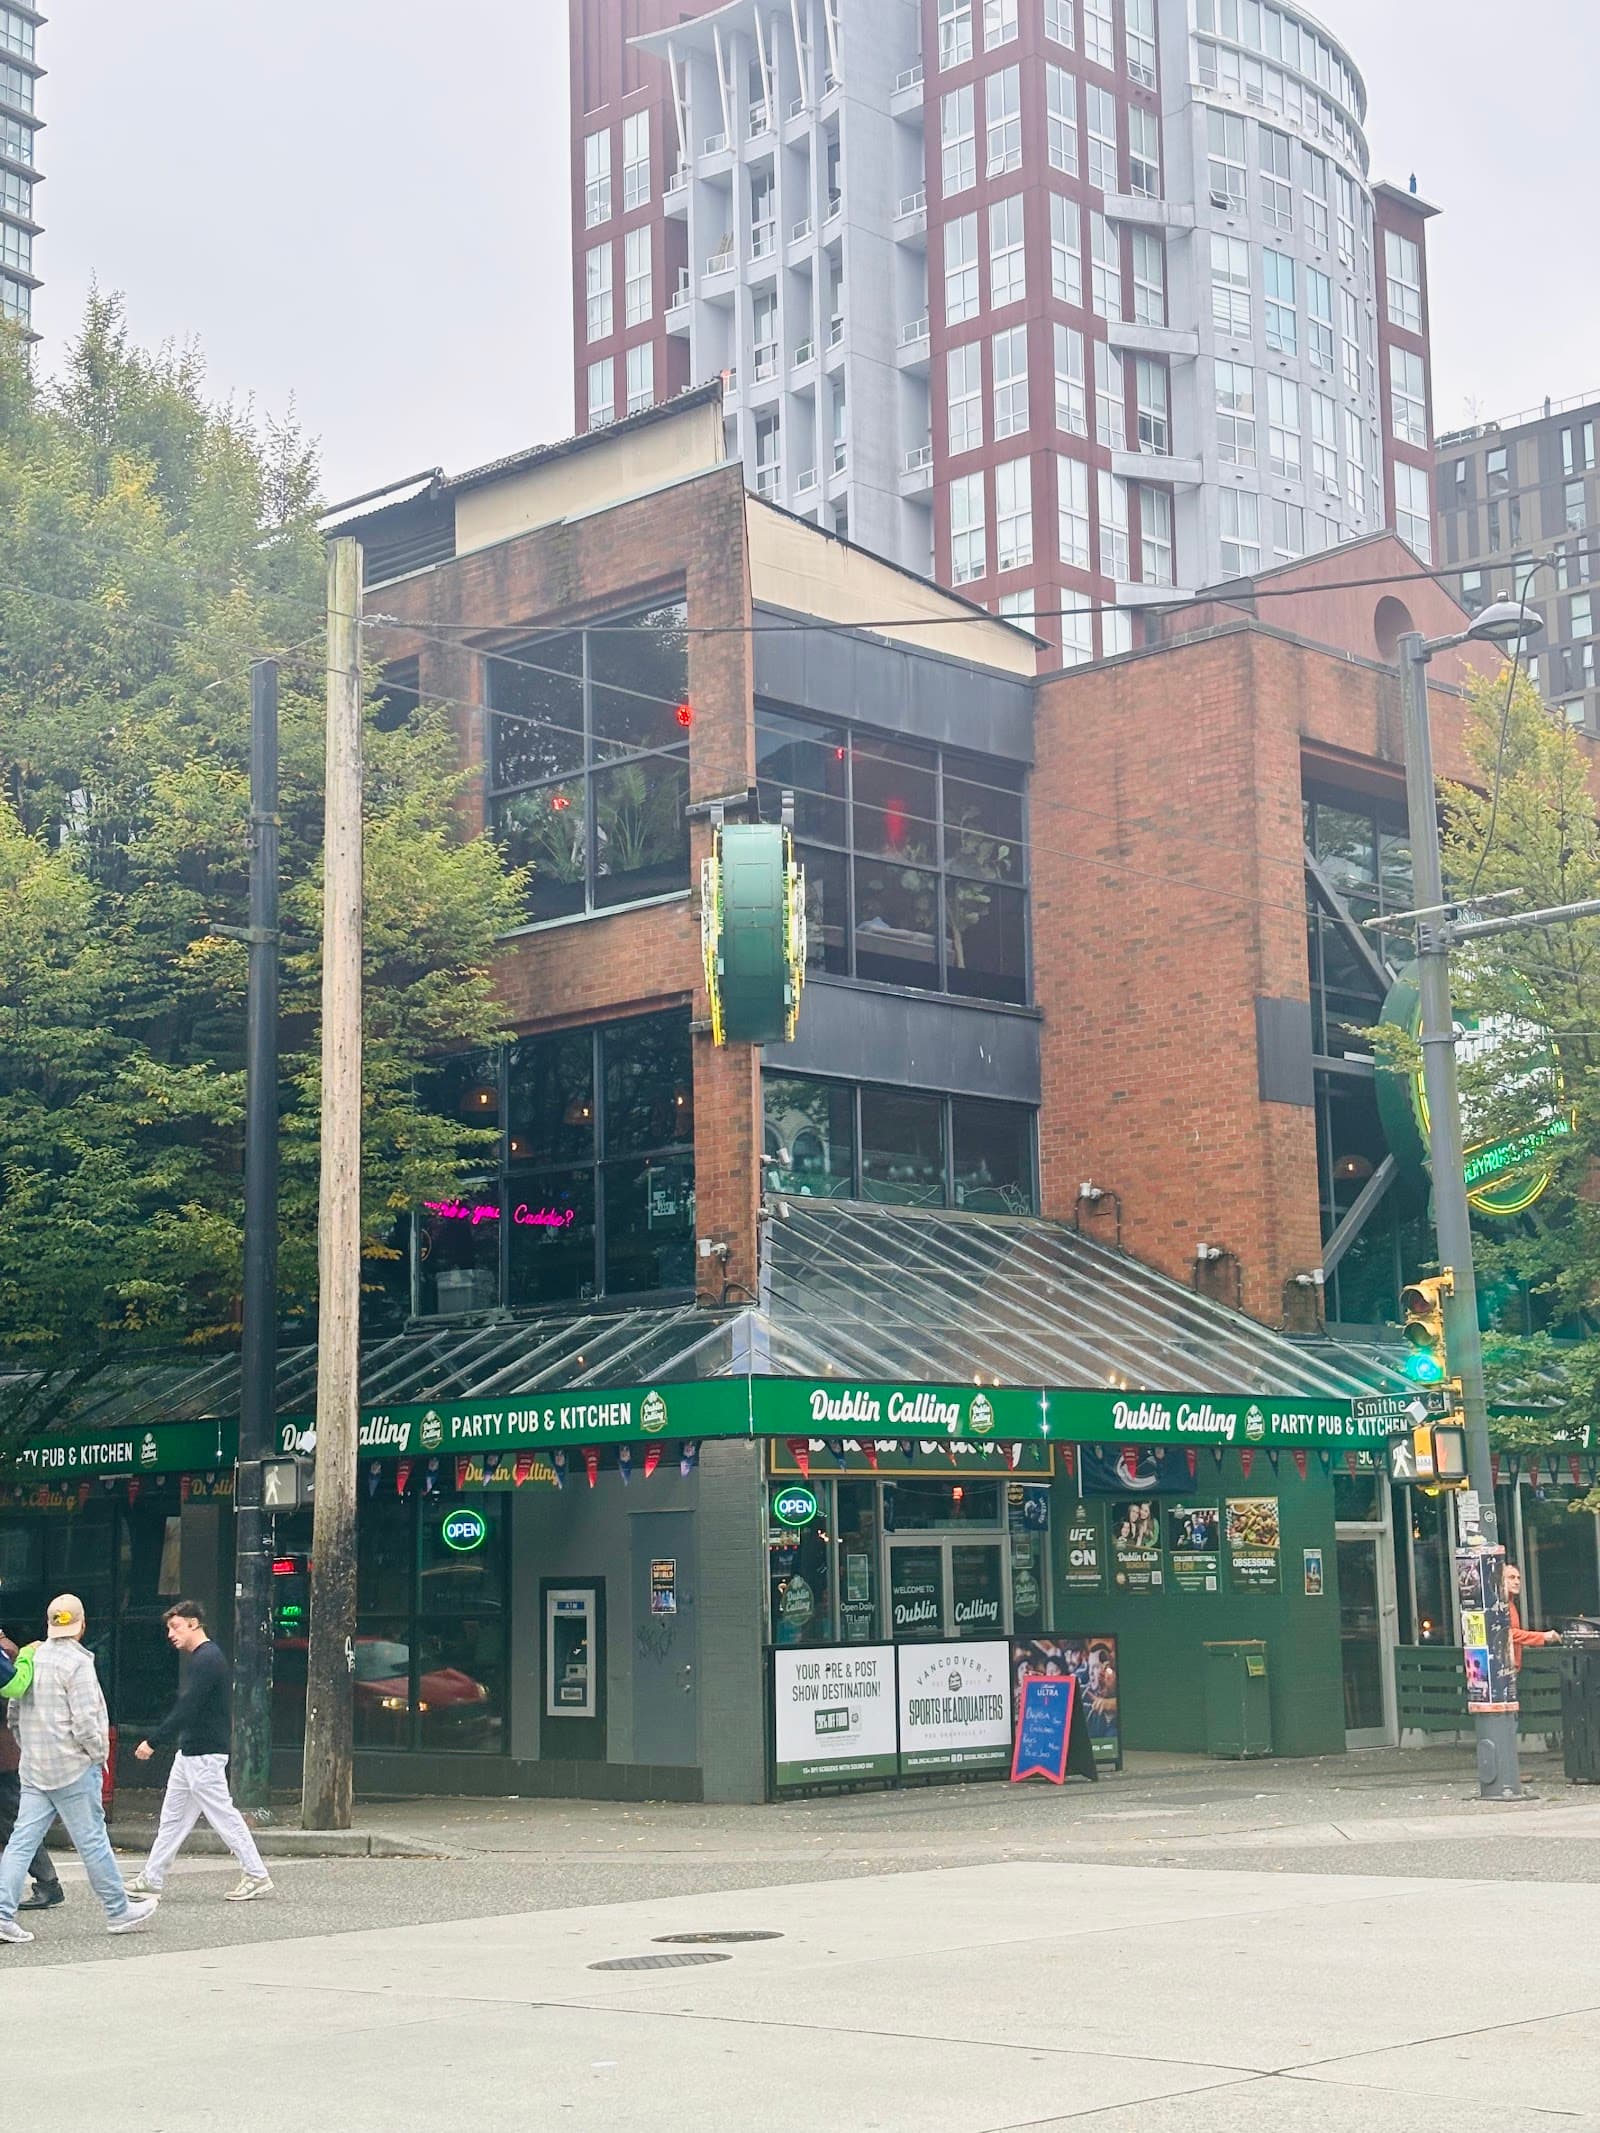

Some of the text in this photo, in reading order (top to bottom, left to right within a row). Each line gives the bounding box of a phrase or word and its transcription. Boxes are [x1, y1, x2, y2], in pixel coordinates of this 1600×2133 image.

[514, 1204, 574, 1227] Caddie?
[809, 1389, 960, 1433] Dublin Calling
[1357, 1398, 1406, 1416] Smithe
[452, 1403, 631, 1438] PARTY PUB & KITCHEN
[1113, 1401, 1237, 1440] Dublin Calling
[1272, 1414, 1314, 1435] PARTY
[1317, 1415, 1342, 1435] PUB
[1346, 1416, 1354, 1436] &
[359, 1416, 411, 1451] alling
[42, 1448, 65, 1467] PUB
[68, 1447, 77, 1465] &
[80, 1442, 133, 1465] KITCHEN
[780, 1500, 812, 1513] OPEN
[447, 1523, 481, 1538] OPEN
[1069, 1528, 1095, 1541] UFC
[1070, 1549, 1096, 1566] ON
[1117, 1552, 1158, 1562] Dublin Club
[787, 1590, 809, 1601] Dublin
[893, 1584, 935, 1594] WELCOME TO
[786, 1600, 810, 1612] Calling
[840, 1602, 875, 1612] Open Daily
[894, 1599, 998, 1624] Dublin Calling
[795, 1661, 877, 1680] YOUR PRE & POST
[792, 1681, 880, 1702] SHOW DESTINATION!
[1037, 1689, 1059, 1697] ULTRA
[909, 1698, 940, 1726] SPORTS
[942, 1694, 1004, 1726] HEADQUARTERS
